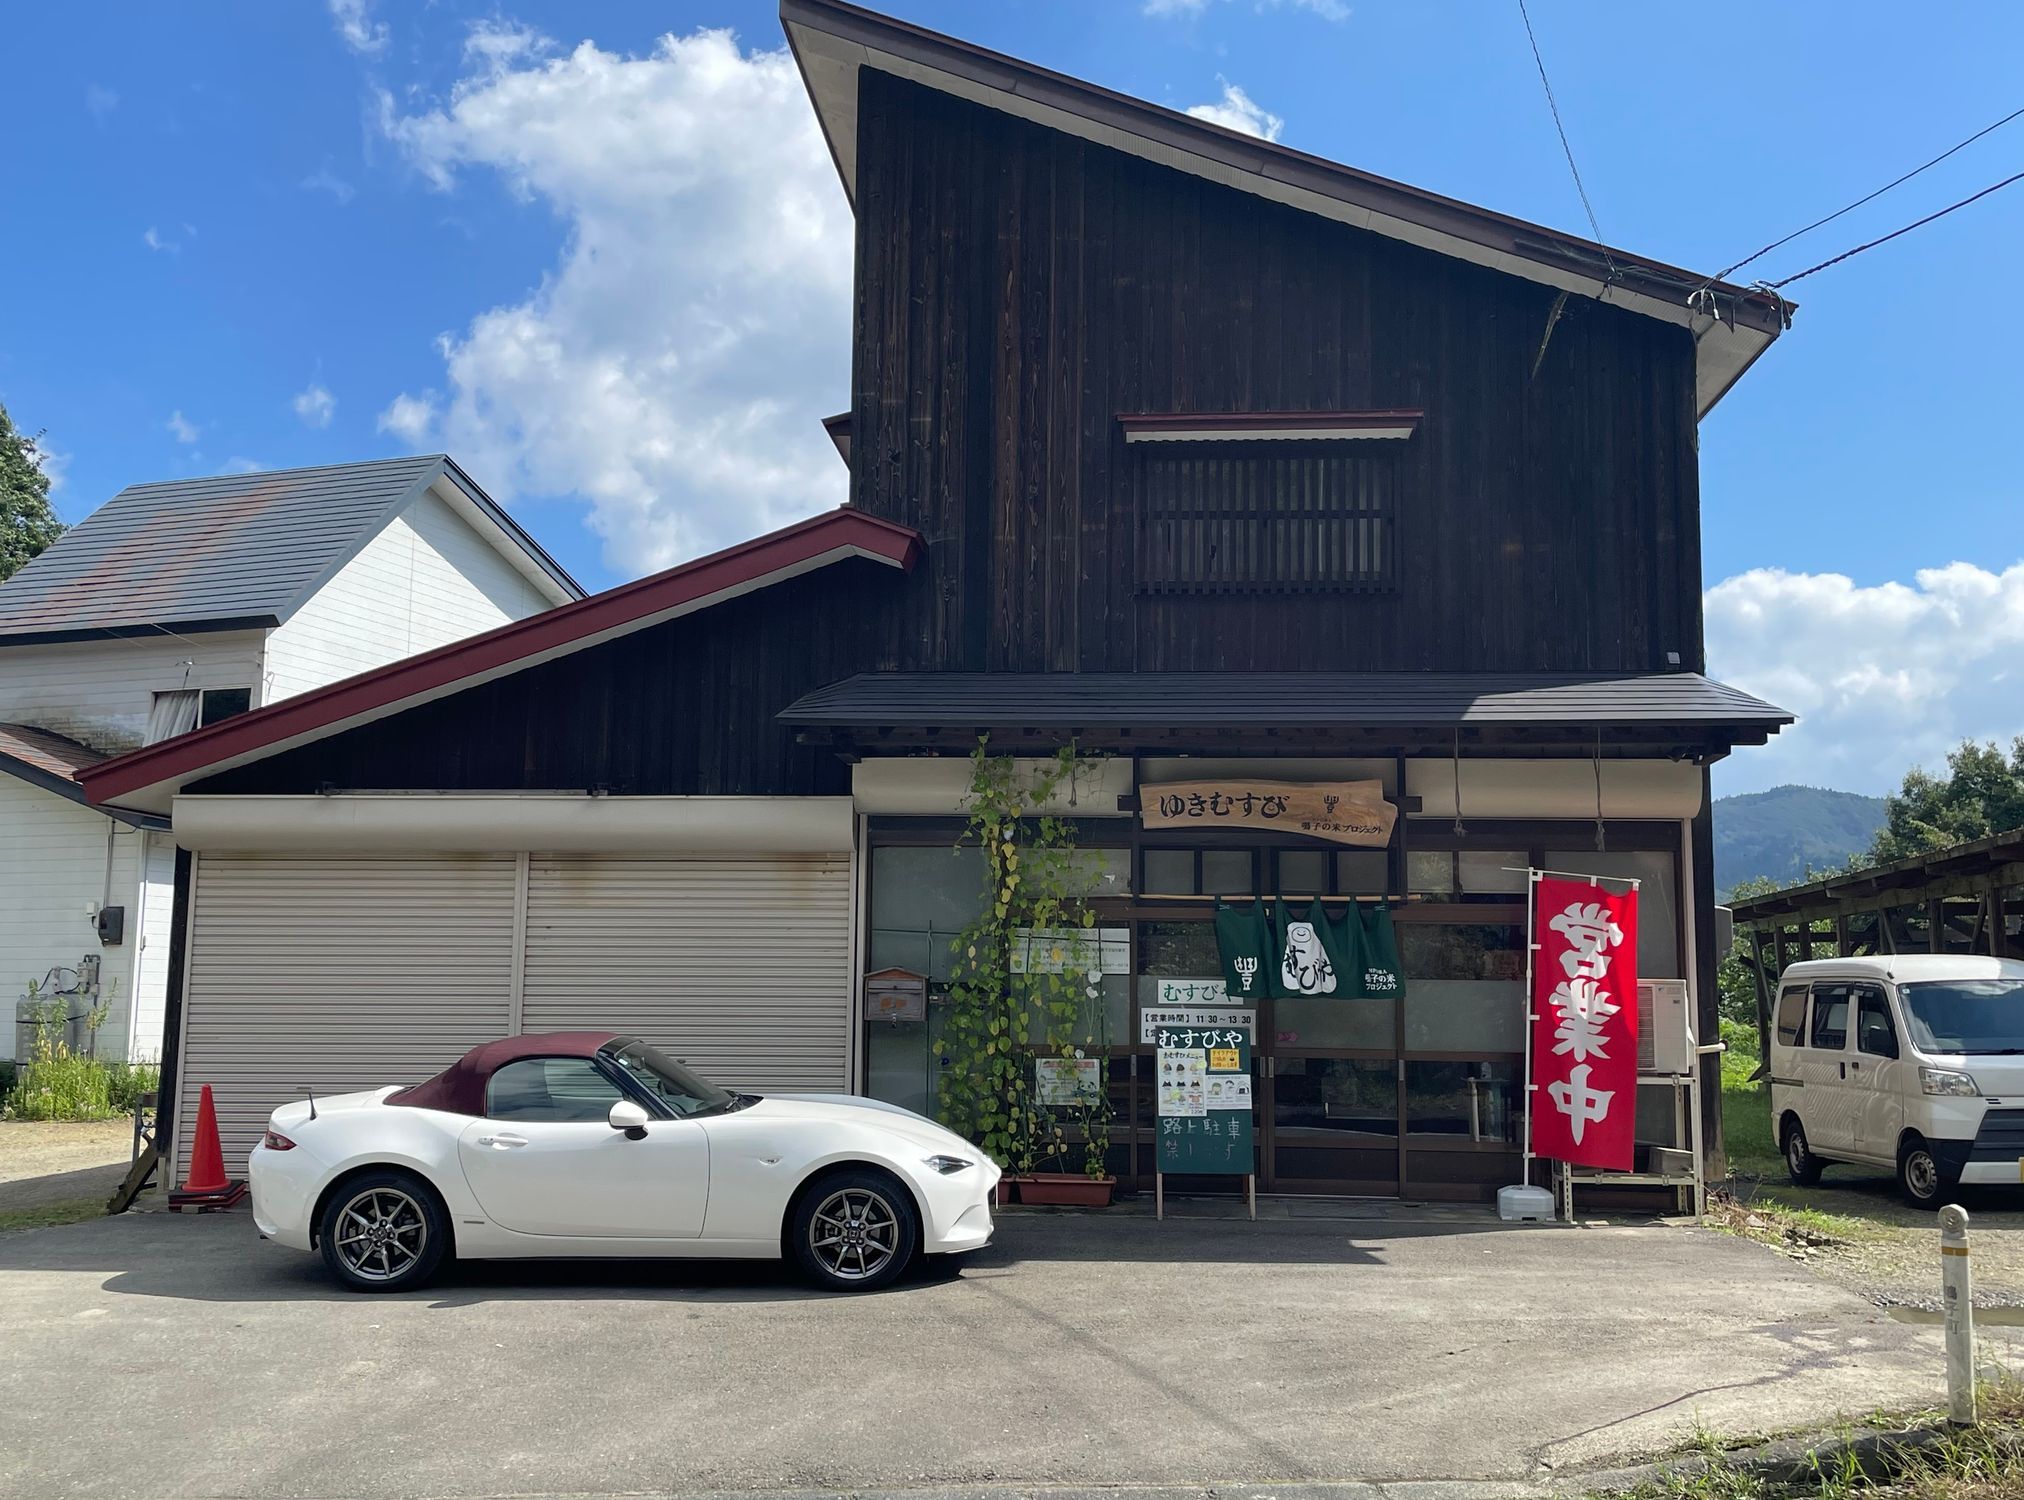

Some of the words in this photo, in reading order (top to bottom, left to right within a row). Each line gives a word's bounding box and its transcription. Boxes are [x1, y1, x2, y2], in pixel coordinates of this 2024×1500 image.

[1160, 792, 1290, 819] ゆきむすび
[1548, 902, 1624, 1146] 営業中
[1158, 1029, 1243, 1049] むすびや
[1163, 1116, 1241, 1140] 路上駐車
